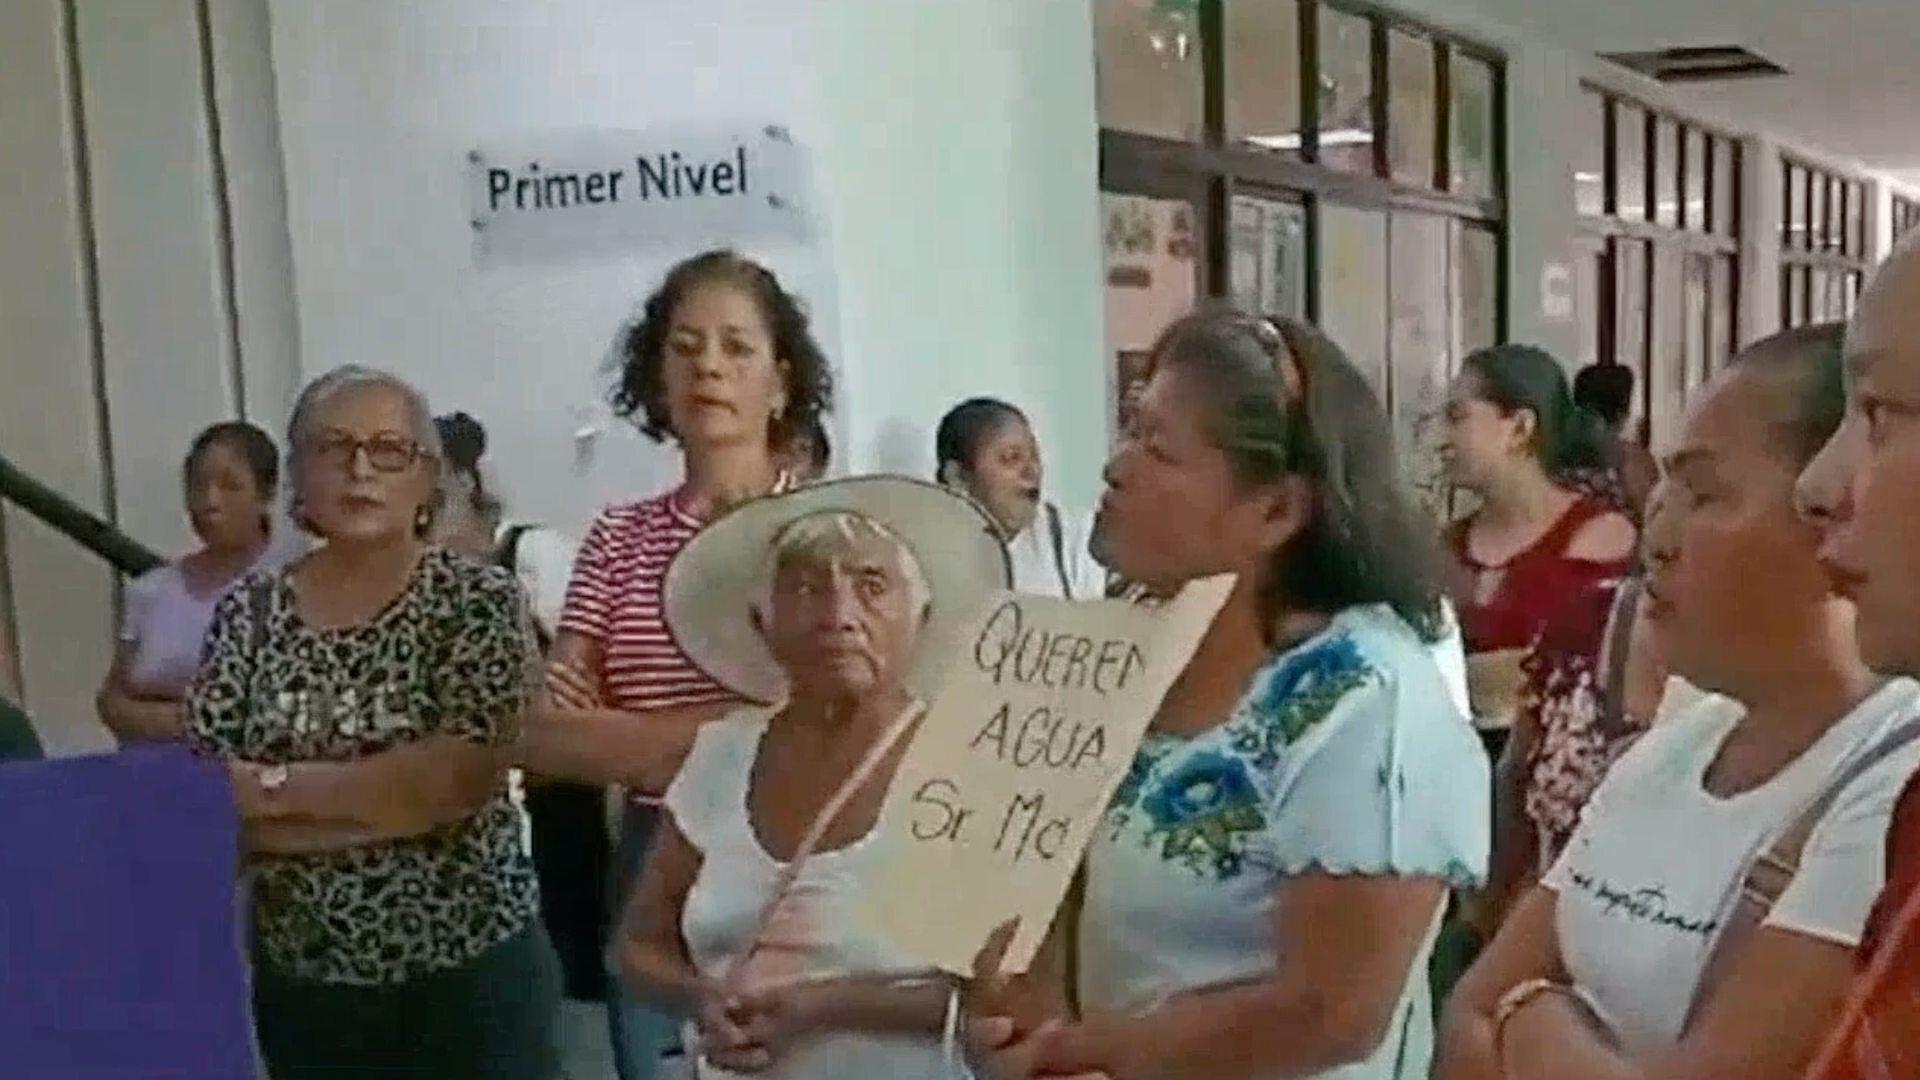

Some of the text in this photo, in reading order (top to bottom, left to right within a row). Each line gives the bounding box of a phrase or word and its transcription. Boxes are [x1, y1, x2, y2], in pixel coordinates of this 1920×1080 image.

[488, 145, 748, 210] Primer Nivel
[969, 703, 1105, 768] AGUA
[911, 778, 974, 841] Sr
